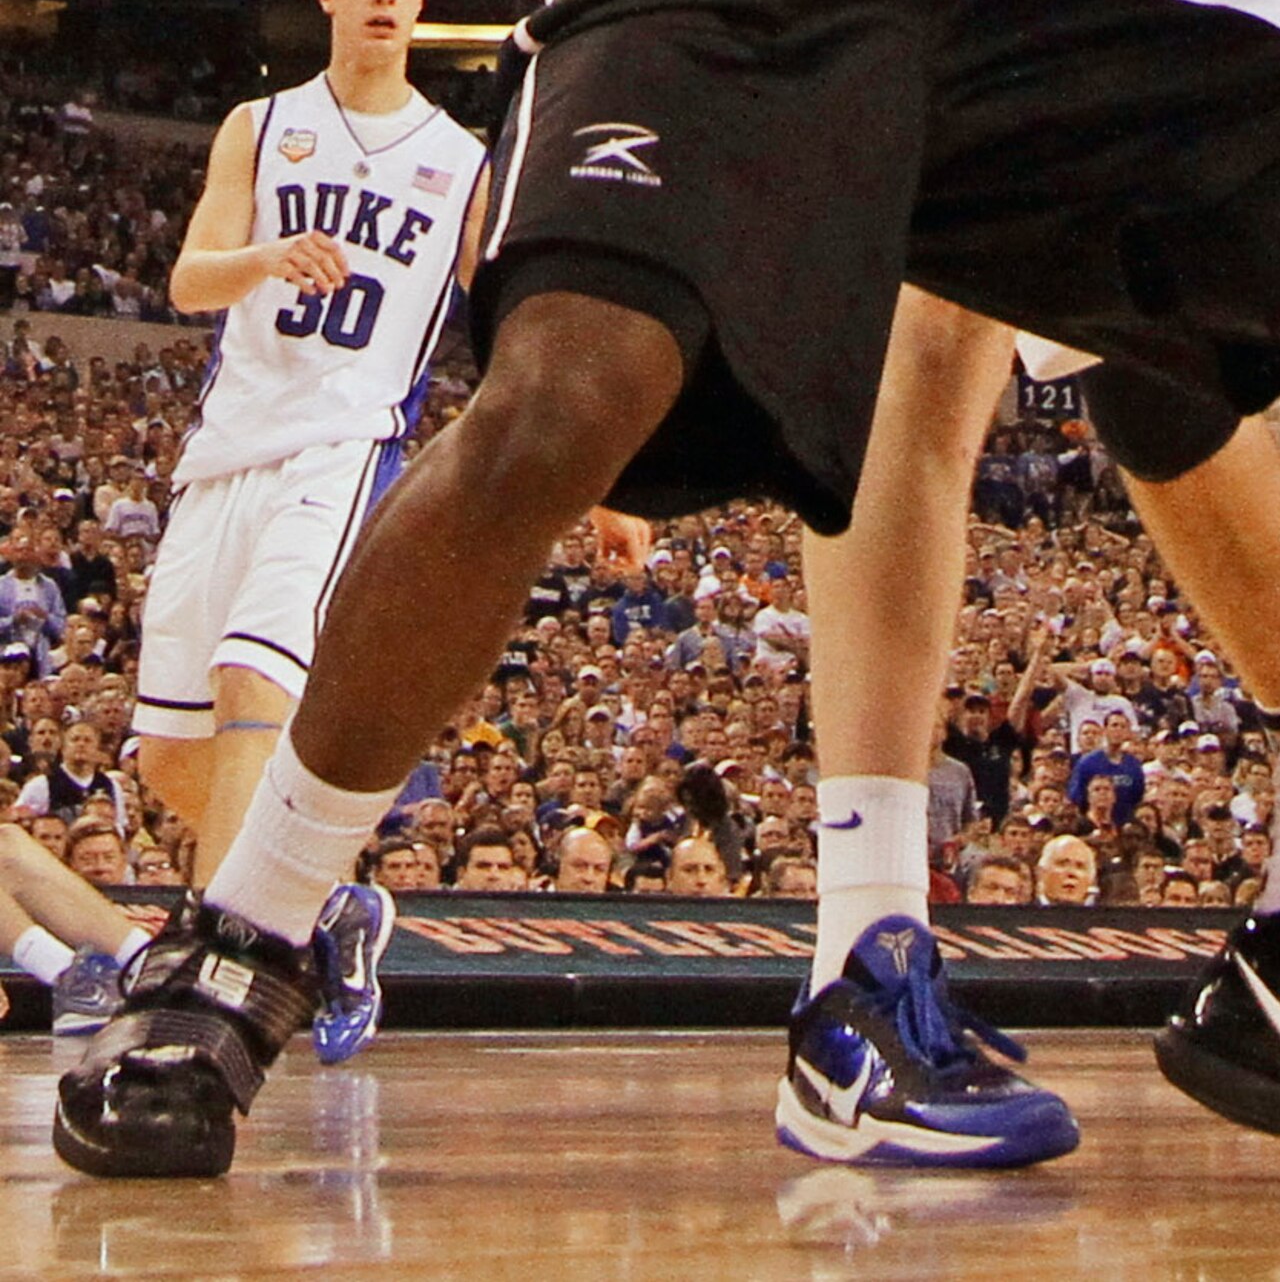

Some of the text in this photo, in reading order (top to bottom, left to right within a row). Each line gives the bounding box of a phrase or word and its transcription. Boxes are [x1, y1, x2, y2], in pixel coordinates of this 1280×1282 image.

[276, 182, 435, 268] DUKE
[275, 272, 385, 351] 30
[1024, 384, 1076, 410] 121
[394, 917, 817, 957] BUTLER
